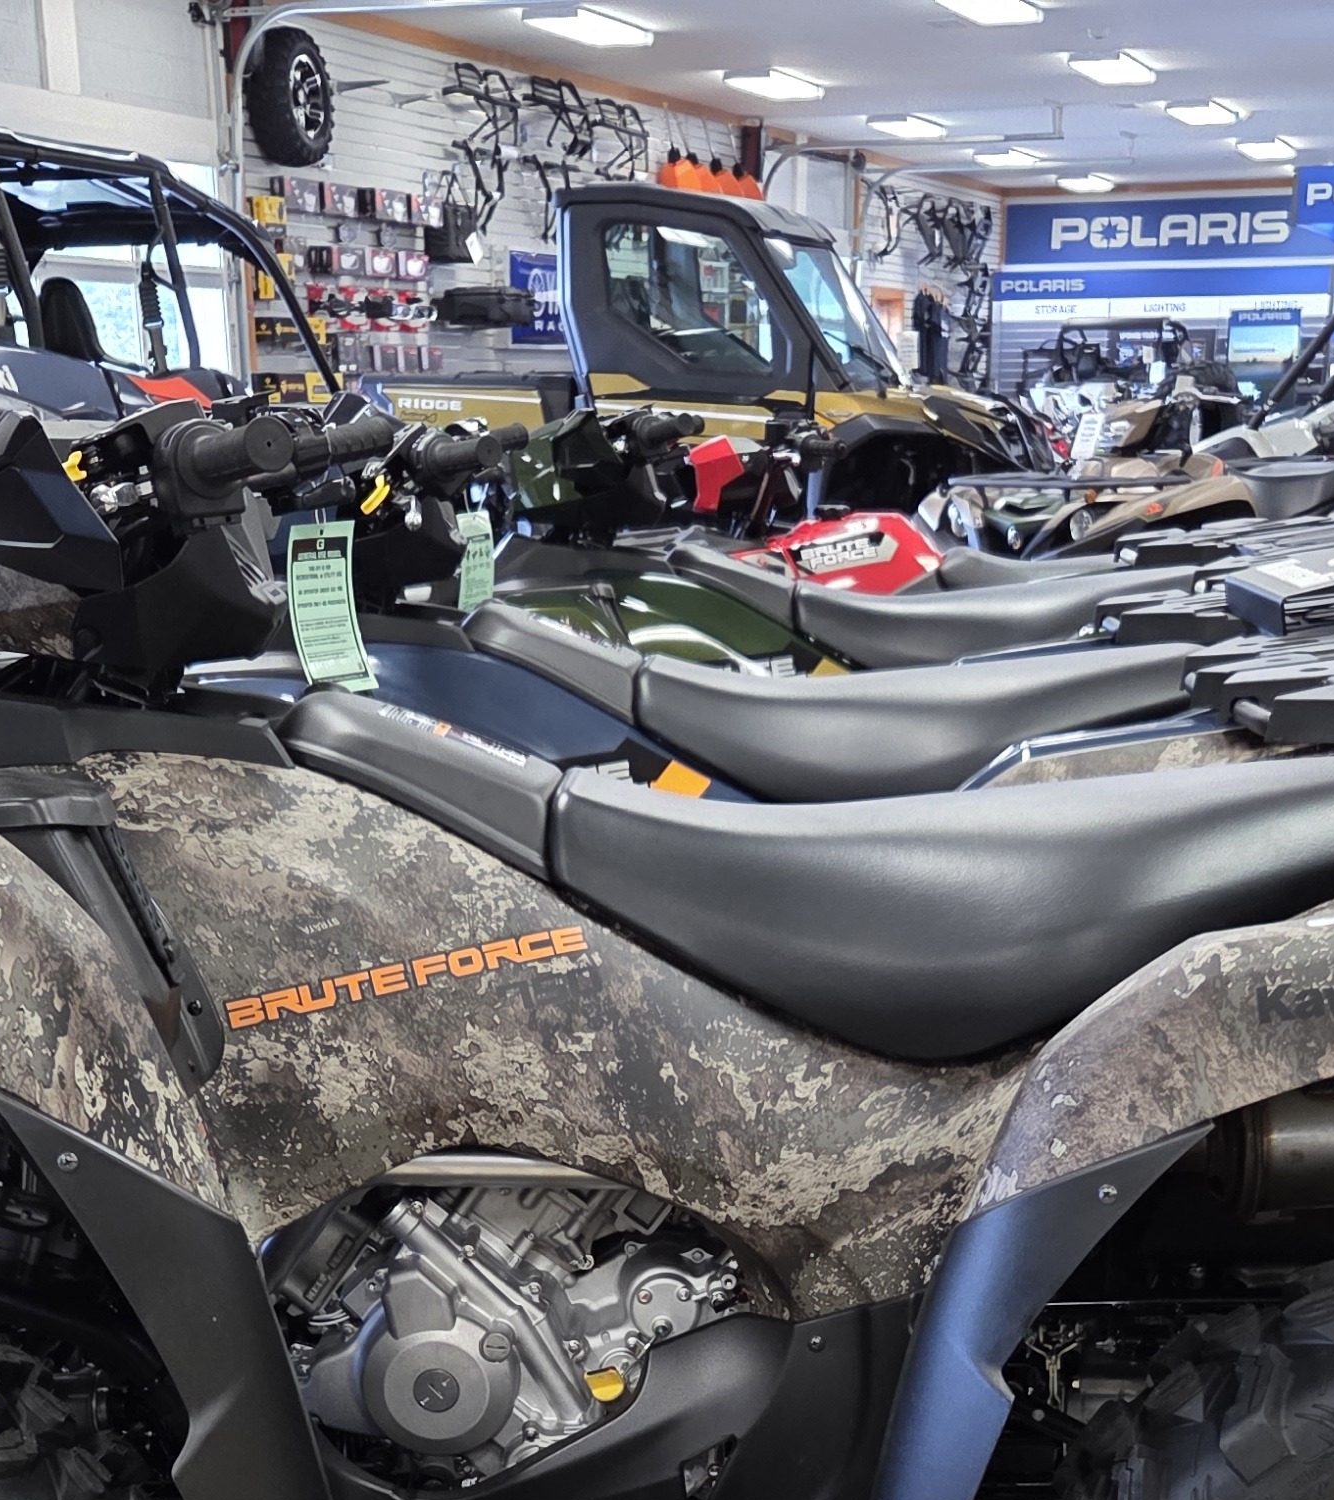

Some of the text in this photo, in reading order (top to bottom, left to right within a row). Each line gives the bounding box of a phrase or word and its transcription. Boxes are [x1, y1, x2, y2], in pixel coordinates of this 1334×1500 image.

[1051, 210, 1290, 250] POLARIS
[1001, 278, 1086, 294] POLARIS
[1034, 304, 1078, 315] STORAGE
[1143, 302, 1187, 313] LIGHTING
[1238, 311, 1292, 322] POLARIS
[397, 398, 462, 412] RIDGE
[800, 537, 870, 561] BRUTE
[809, 547, 878, 570] FORCE
[225, 926, 589, 1031] BRUTE FORCE
